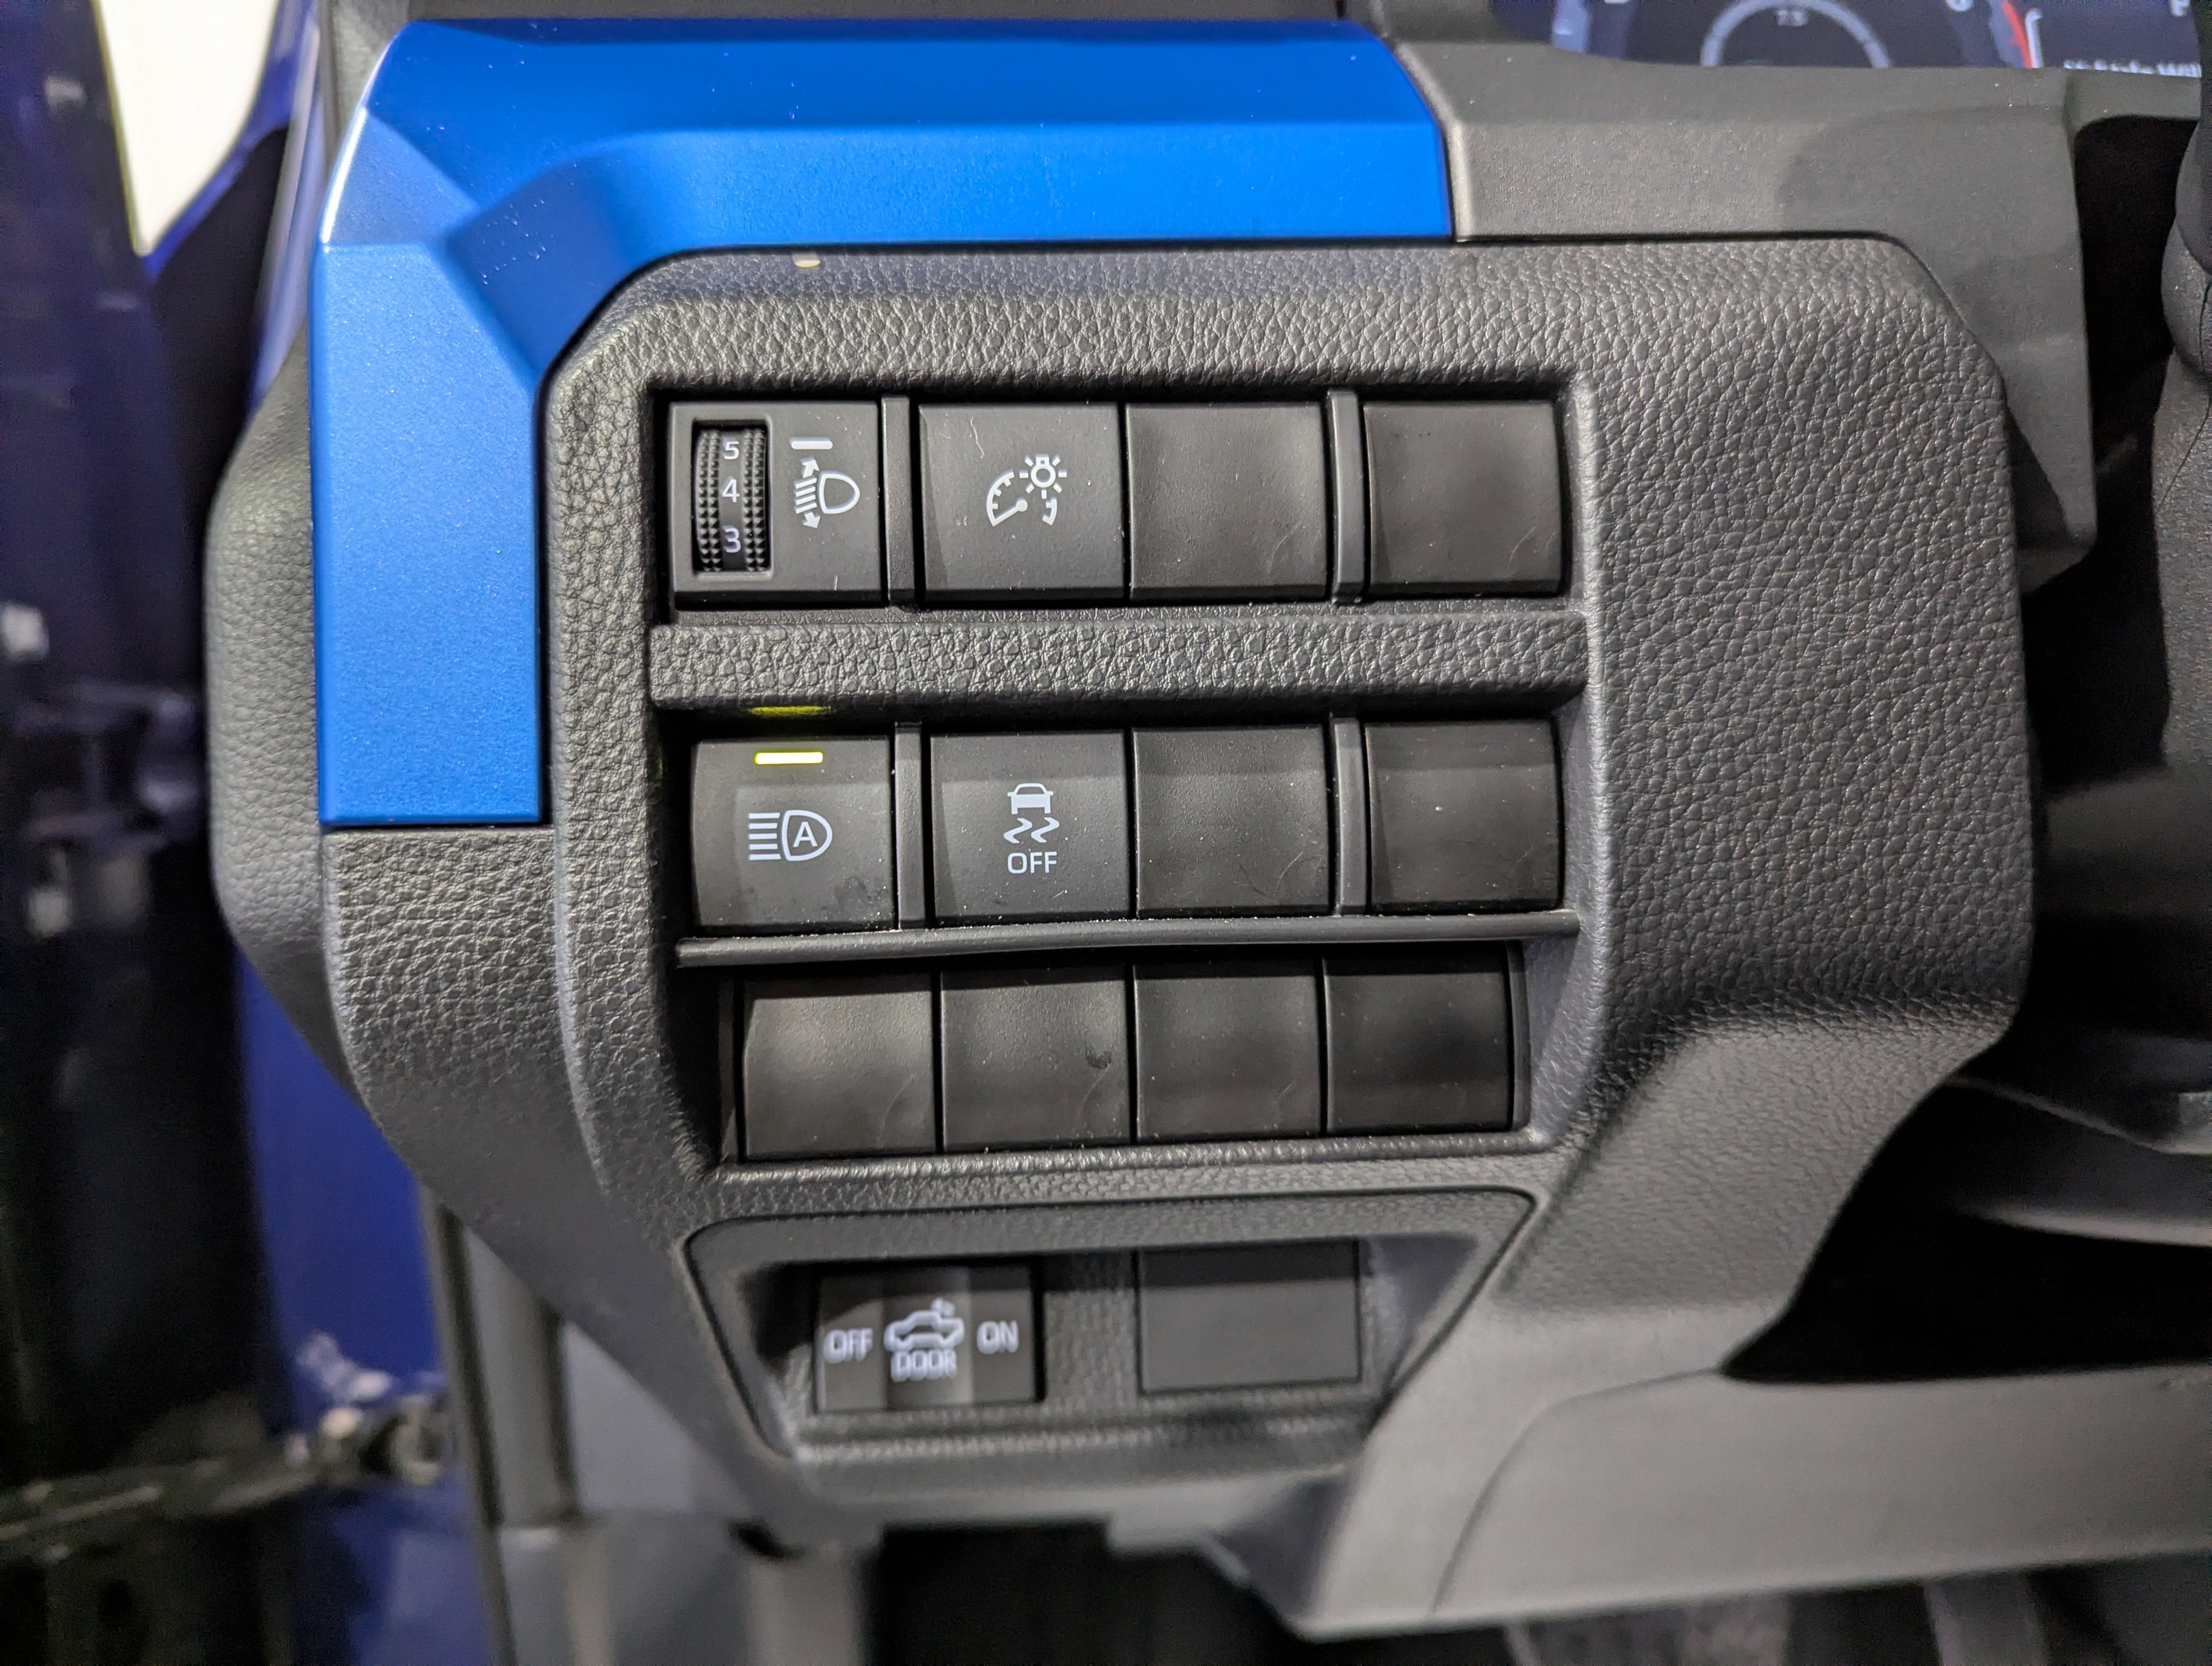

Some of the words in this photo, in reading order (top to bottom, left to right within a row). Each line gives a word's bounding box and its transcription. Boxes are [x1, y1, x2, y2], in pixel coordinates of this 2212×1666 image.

[724, 441, 740, 460] 5
[722, 479, 740, 503] 4
[724, 528, 741, 553] 3
[793, 821, 818, 848] A
[1007, 851, 1057, 874] OFF
[824, 1328, 873, 1363] OFF
[978, 1321, 1019, 1354] ON
[891, 1350, 957, 1382] DOOR
